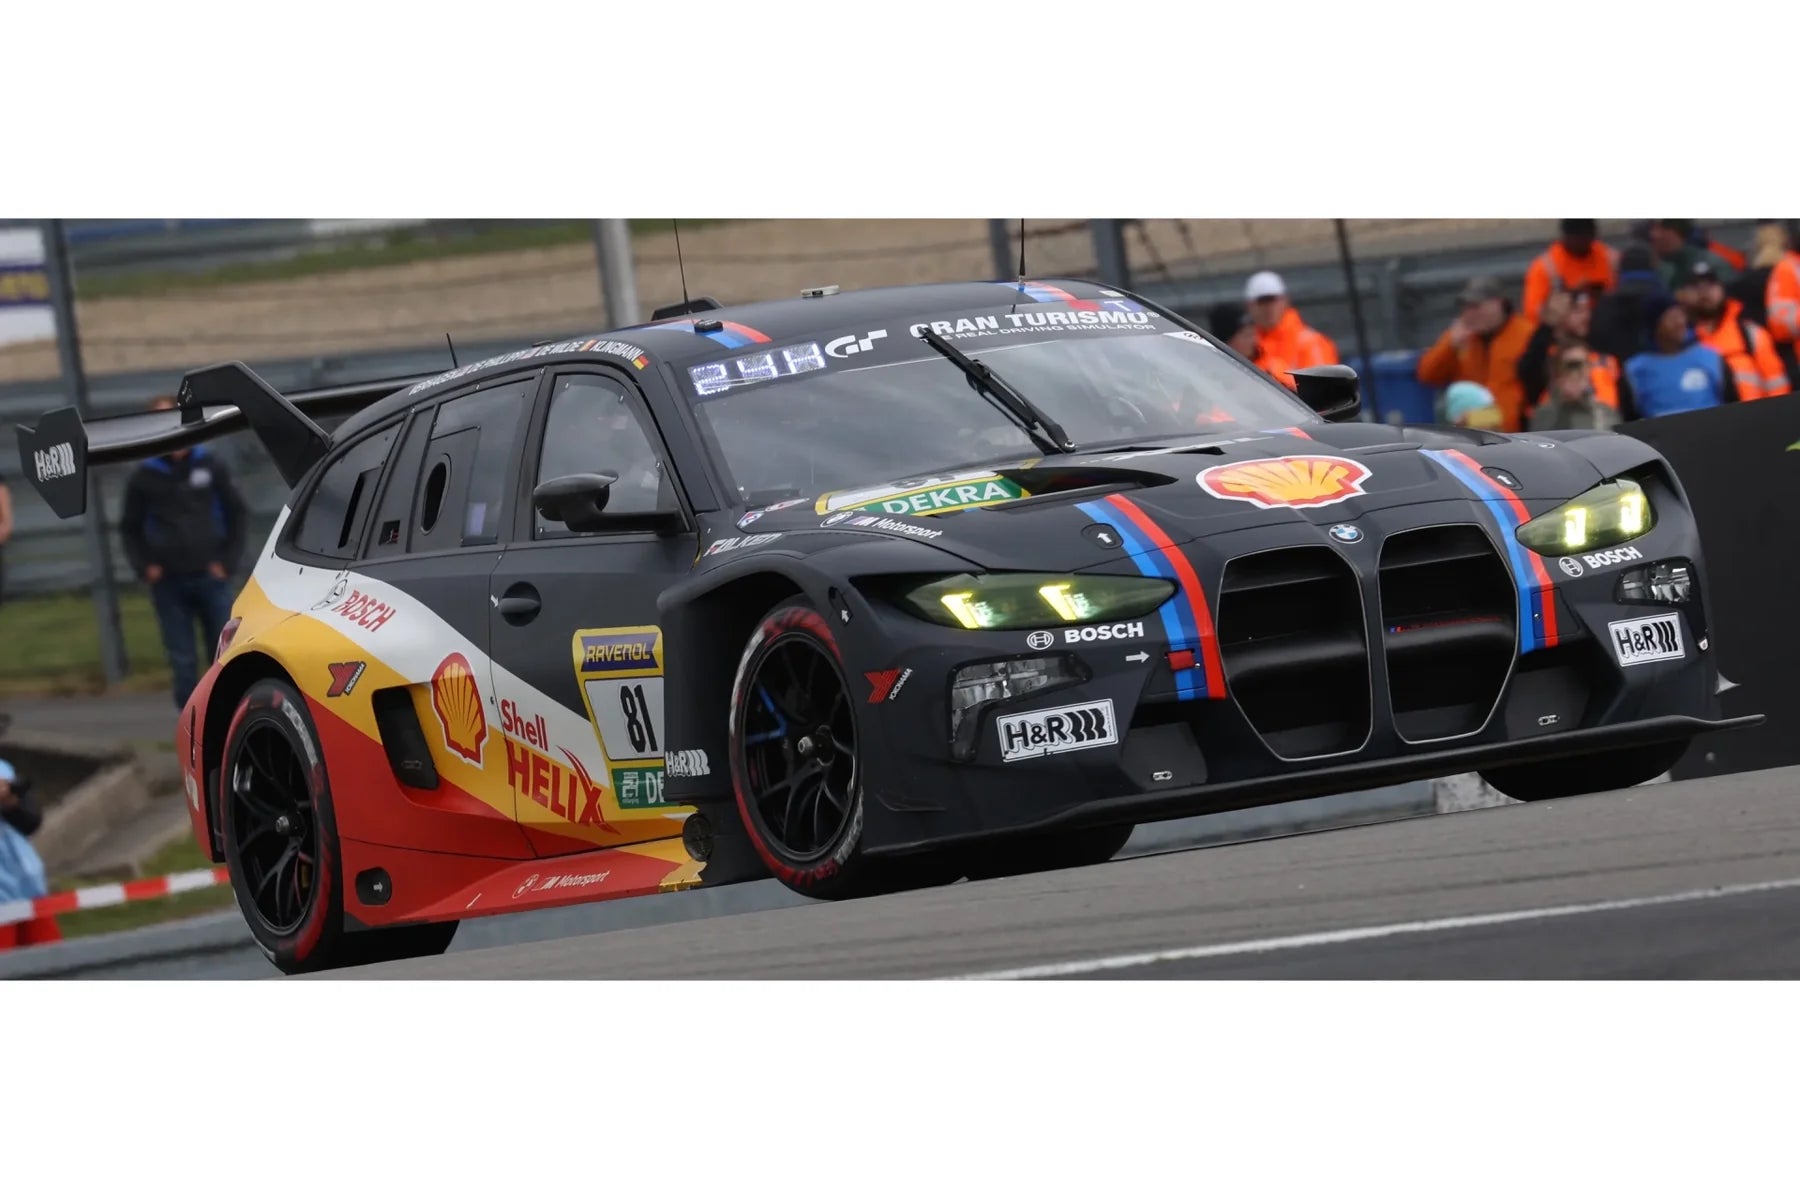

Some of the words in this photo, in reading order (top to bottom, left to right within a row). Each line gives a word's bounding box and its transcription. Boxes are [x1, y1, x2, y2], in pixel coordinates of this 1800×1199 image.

[909, 315, 999, 338] GRAN
[920, 334, 953, 343] TE
[956, 329, 998, 340] REAL
[999, 324, 1065, 334] DRIVING
[1066, 323, 1157, 331] SIMULATOR
[588, 340, 644, 362] KLINGMANN
[34, 446, 61, 482] H&R
[882, 482, 1011, 514] DEKRA
[872, 518, 944, 539] Motorsport
[1582, 546, 1643, 569] BOSCH
[331, 589, 396, 632] BOSCH
[1064, 622, 1144, 643] BOSCH
[1615, 625, 1657, 655] H&R
[585, 643, 650, 663] RAVENOL
[345, 663, 366, 693] YOKOHAMA
[889, 667, 913, 700] YOKOHAMA
[501, 698, 548, 752] Shell
[620, 684, 658, 753] 81
[1005, 716, 1068, 749] H&R
[665, 750, 691, 777] H&R
[504, 737, 622, 835] HELIX
[554, 870, 610, 888] Motorsport
